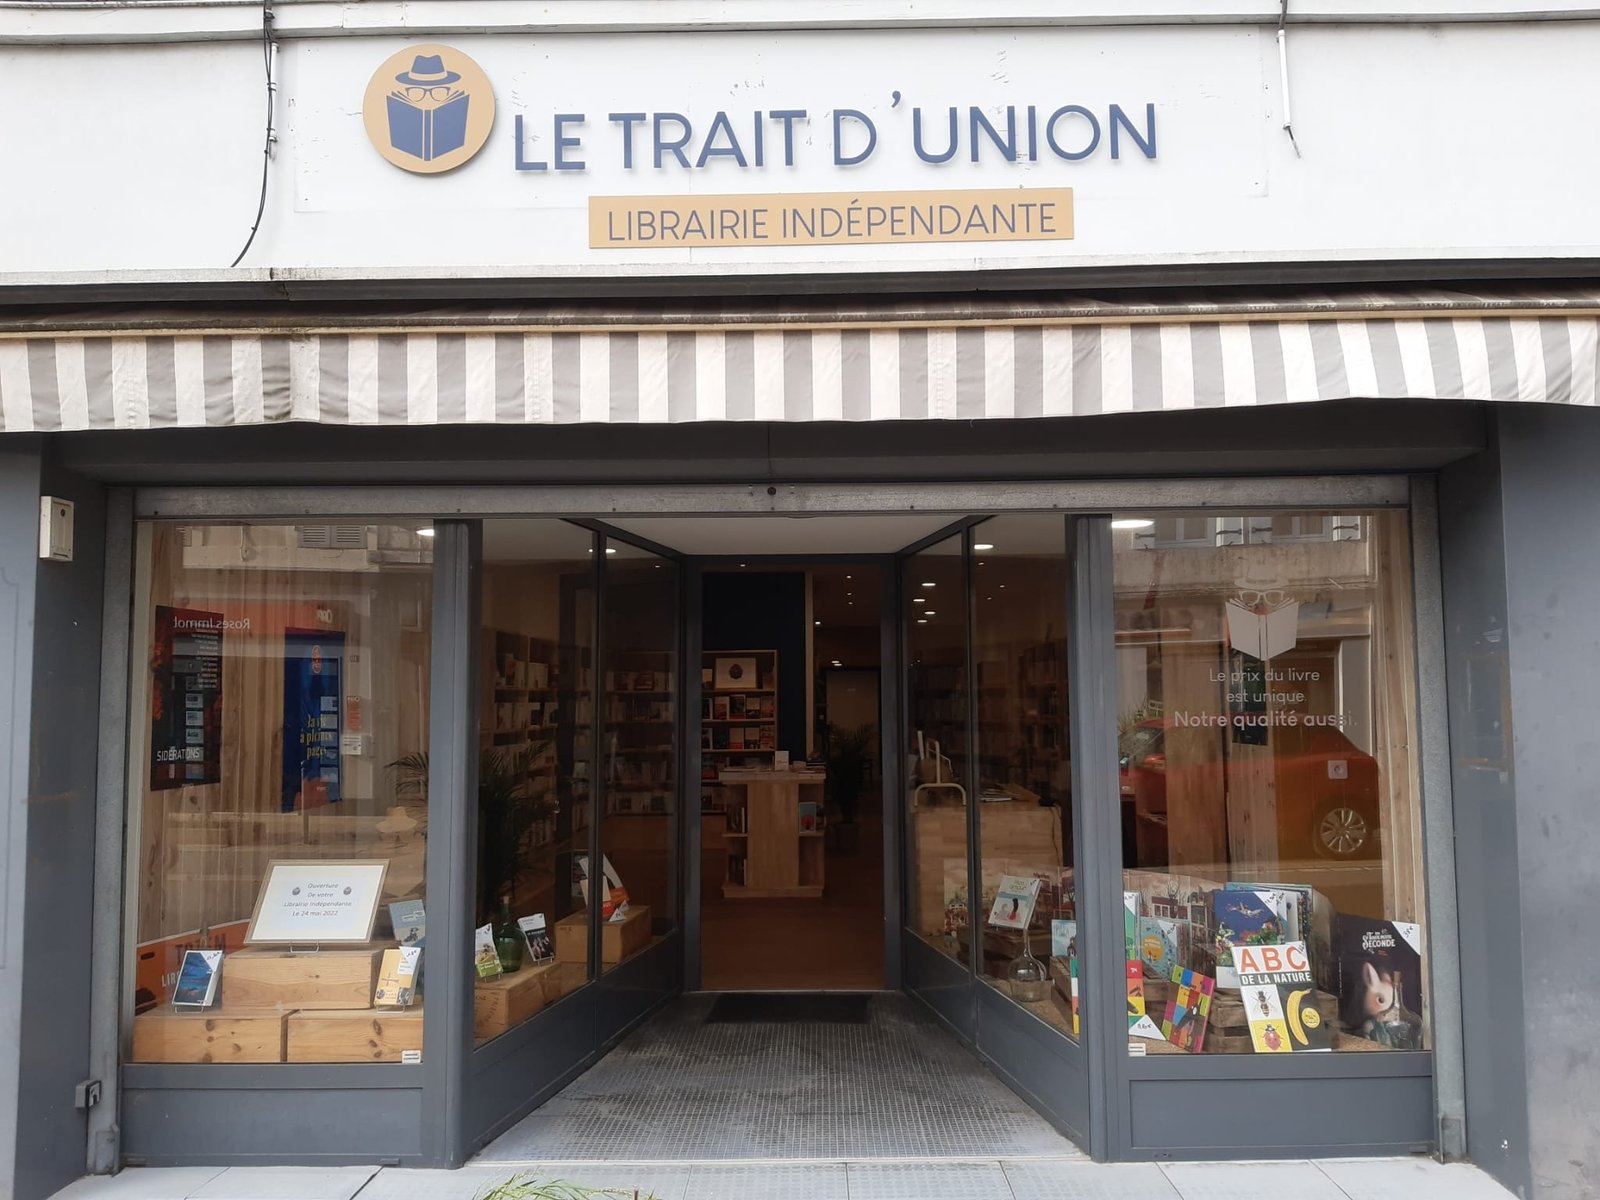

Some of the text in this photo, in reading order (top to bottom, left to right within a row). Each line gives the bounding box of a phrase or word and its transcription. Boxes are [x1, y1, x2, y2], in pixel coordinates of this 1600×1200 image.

[515, 114, 586, 171] LE
[609, 111, 807, 168] TRAIT
[608, 198, 1057, 242] LIBRAIRIE INDÉPENDANTE
[1209, 667, 1320, 686] Le prix du livre
[1226, 690, 1249, 703] est
[1174, 711, 1228, 727] Notre
[1233, 710, 1298, 733] qualité
[1240, 945, 1309, 973] ABC
[1241, 971, 1312, 985] DE LA NATURE
